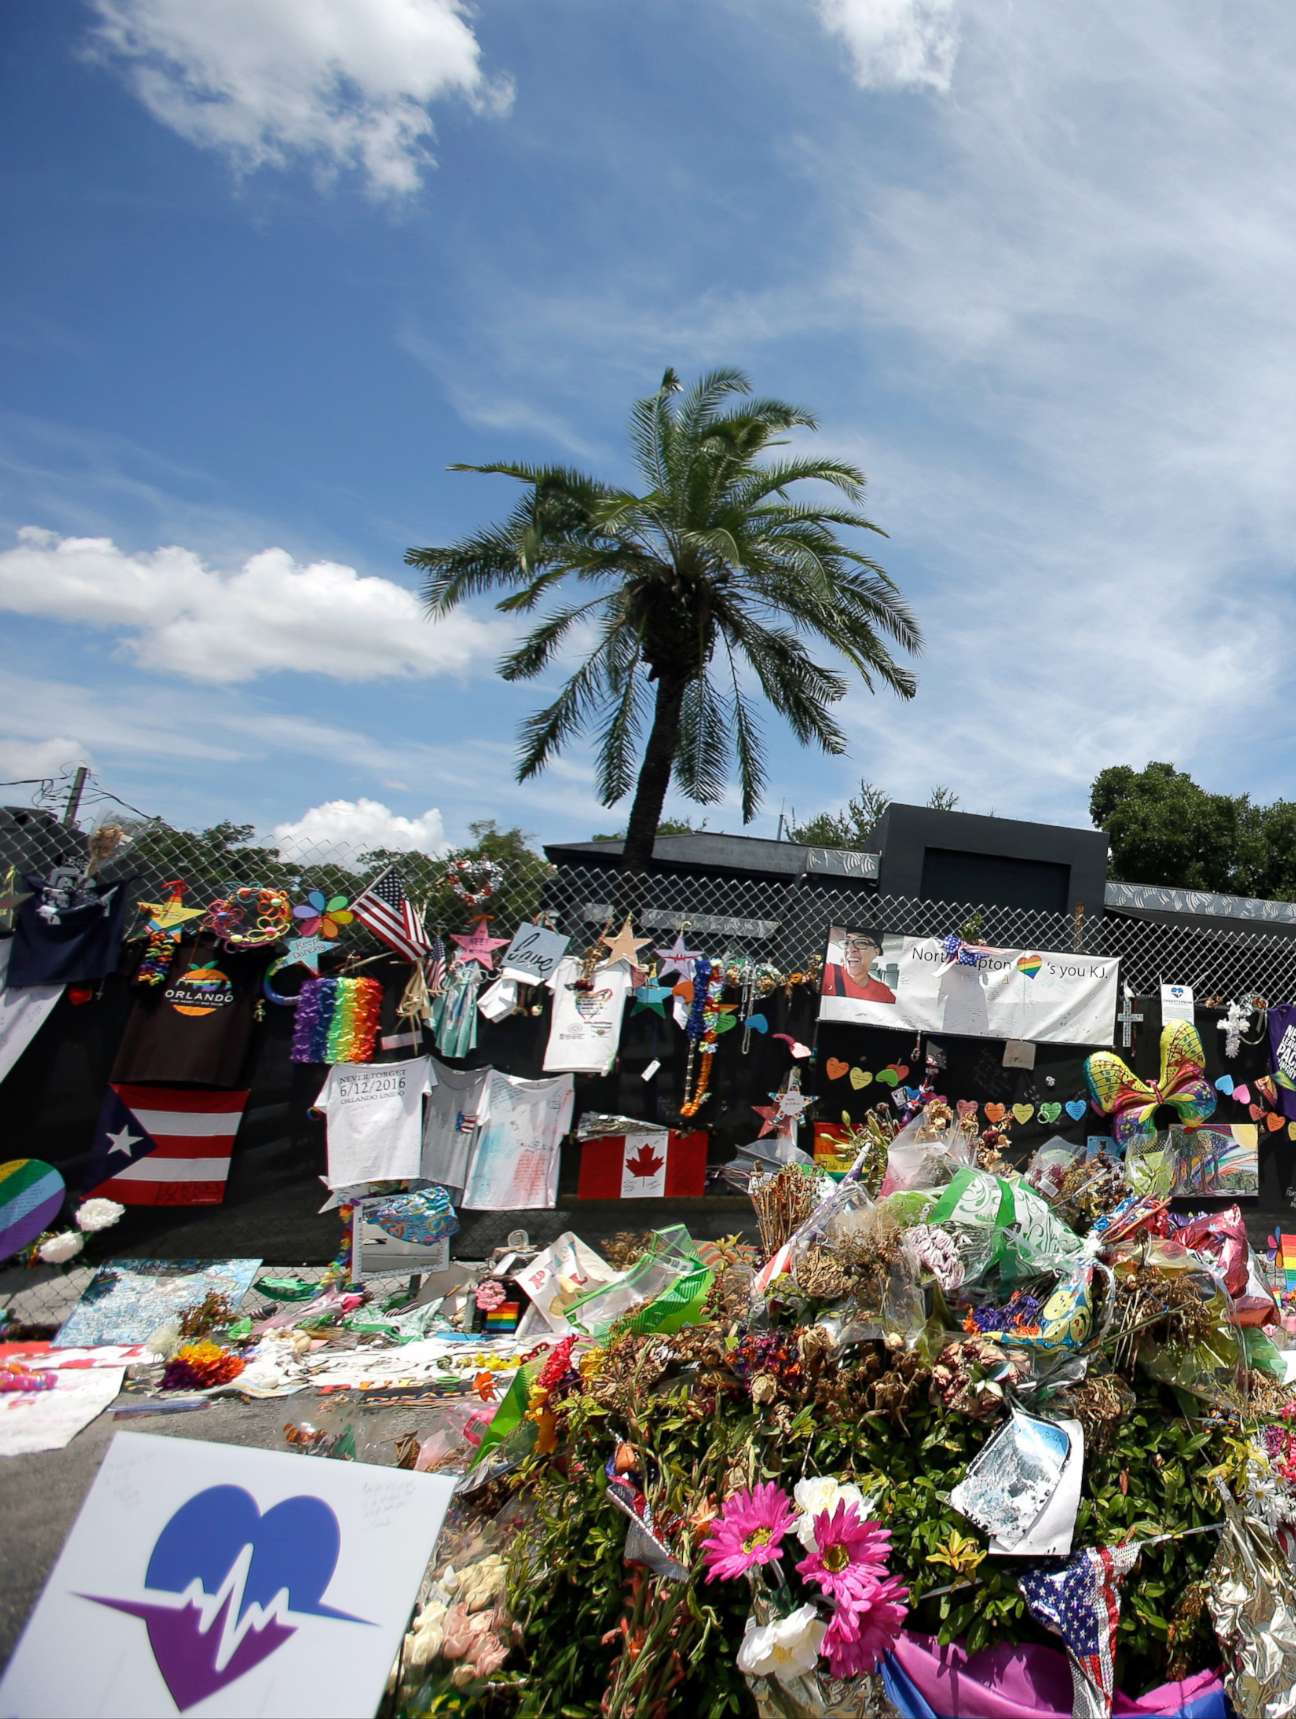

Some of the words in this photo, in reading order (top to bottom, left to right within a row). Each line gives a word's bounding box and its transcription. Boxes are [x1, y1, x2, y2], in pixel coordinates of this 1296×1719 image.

[912, 947, 1012, 971] Nortpton
[1060, 965, 1086, 978] you
[165, 989, 234, 1003] ORLANDO
[340, 1073, 369, 1084] NEVER
[371, 1069, 407, 1079] FORGET
[340, 1077, 406, 1097] 6/12/2016
